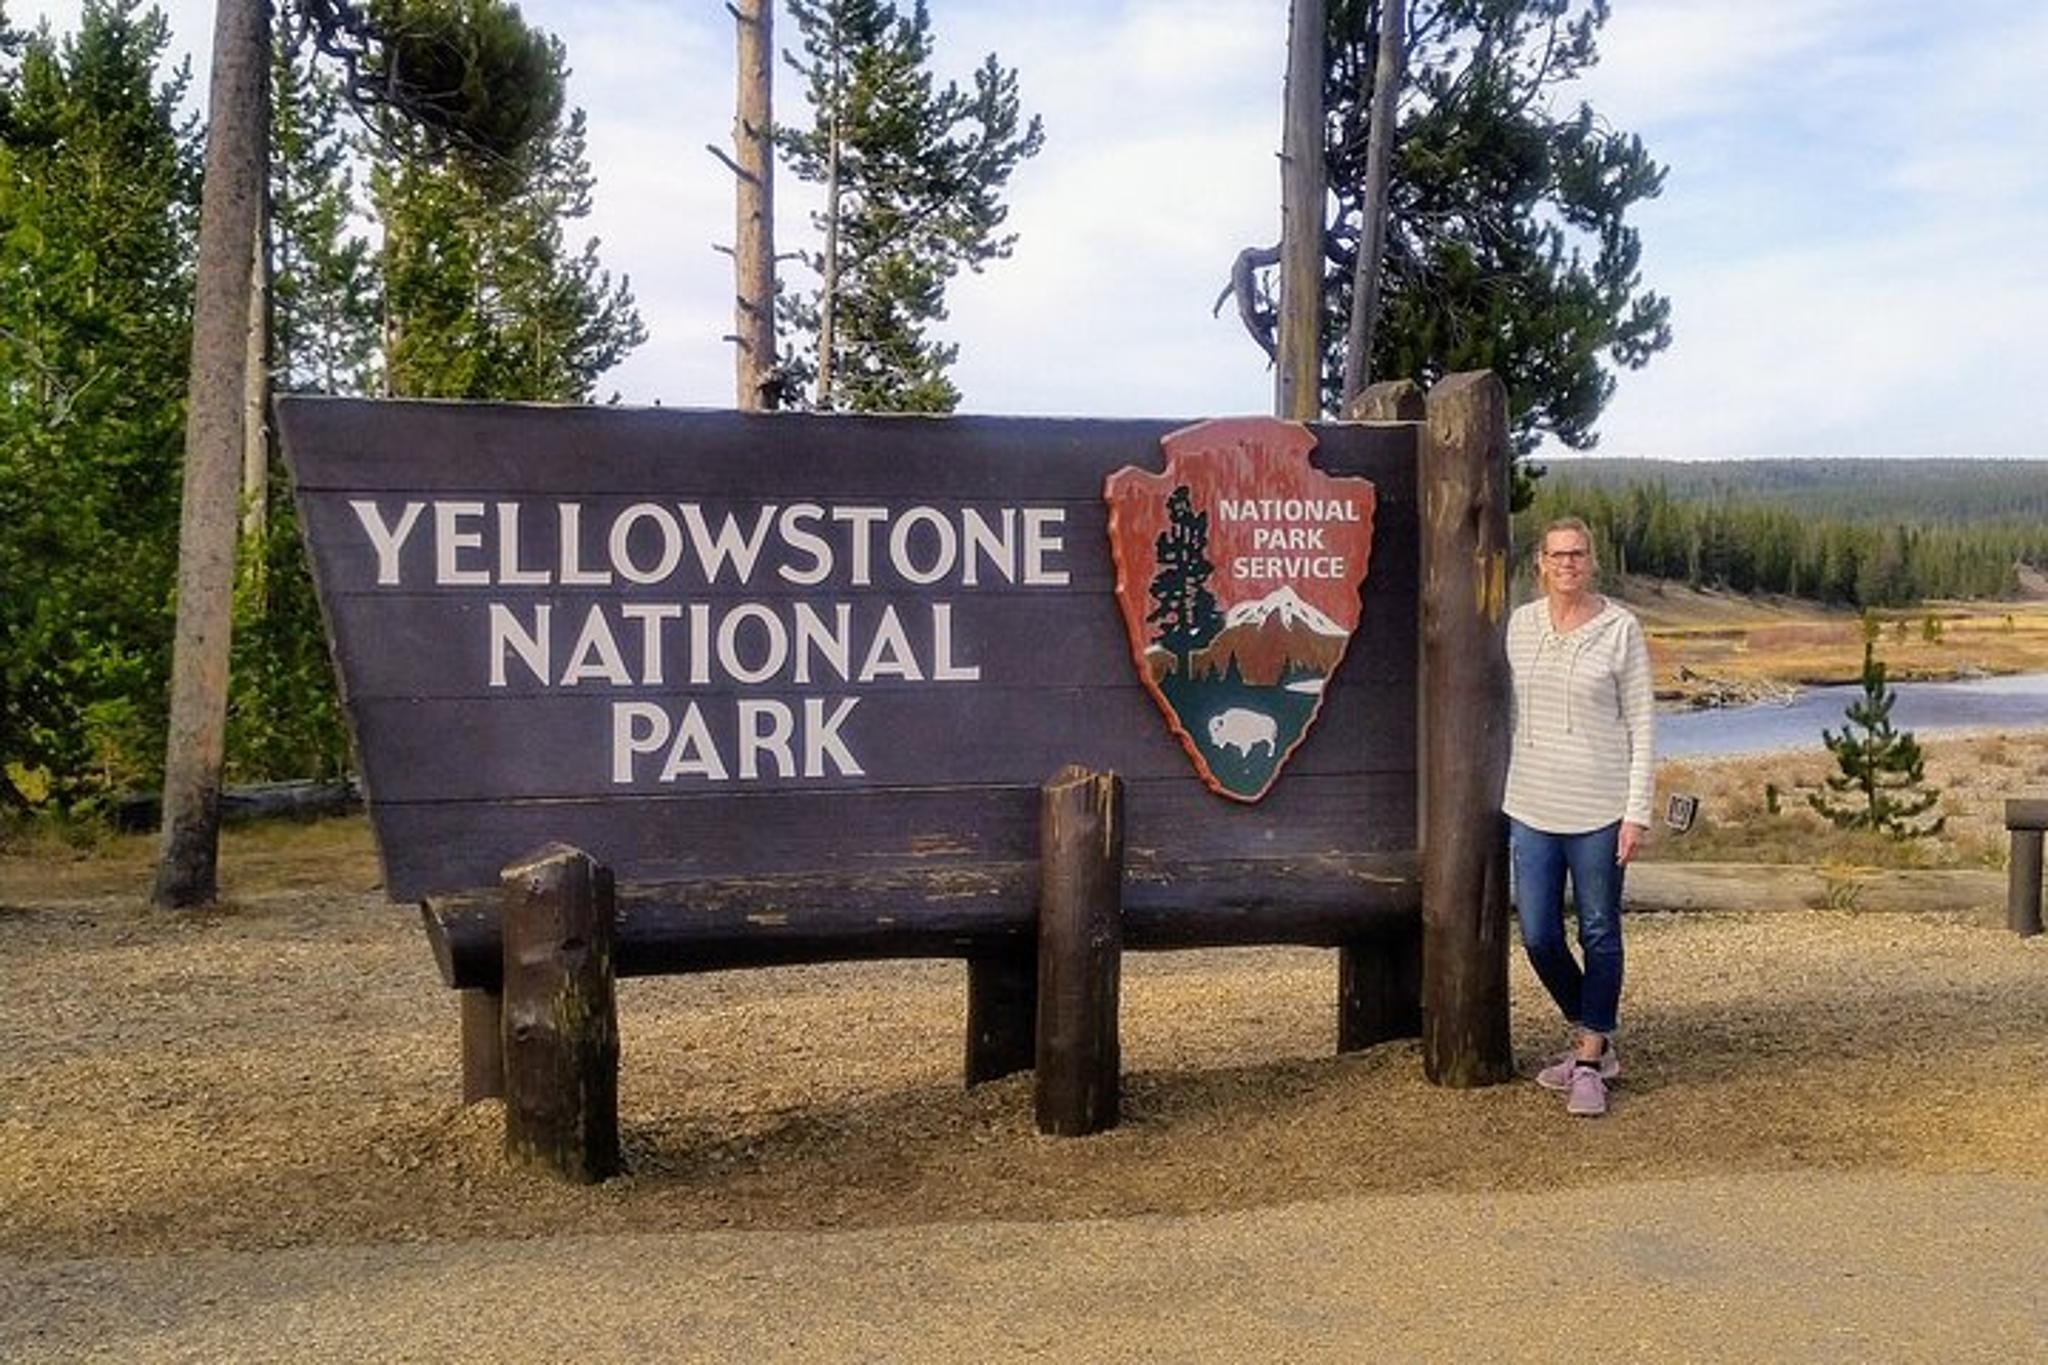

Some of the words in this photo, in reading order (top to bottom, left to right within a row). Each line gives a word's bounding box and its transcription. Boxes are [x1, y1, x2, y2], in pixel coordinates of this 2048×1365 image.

[1218, 499, 1360, 522] NATIONAL
[349, 499, 1071, 587] YELLOWSTONE
[1253, 527, 1325, 550] PARK
[1232, 556, 1345, 579] SERVICE
[488, 601, 981, 688] NATIONAL
[611, 698, 867, 784] PARK
